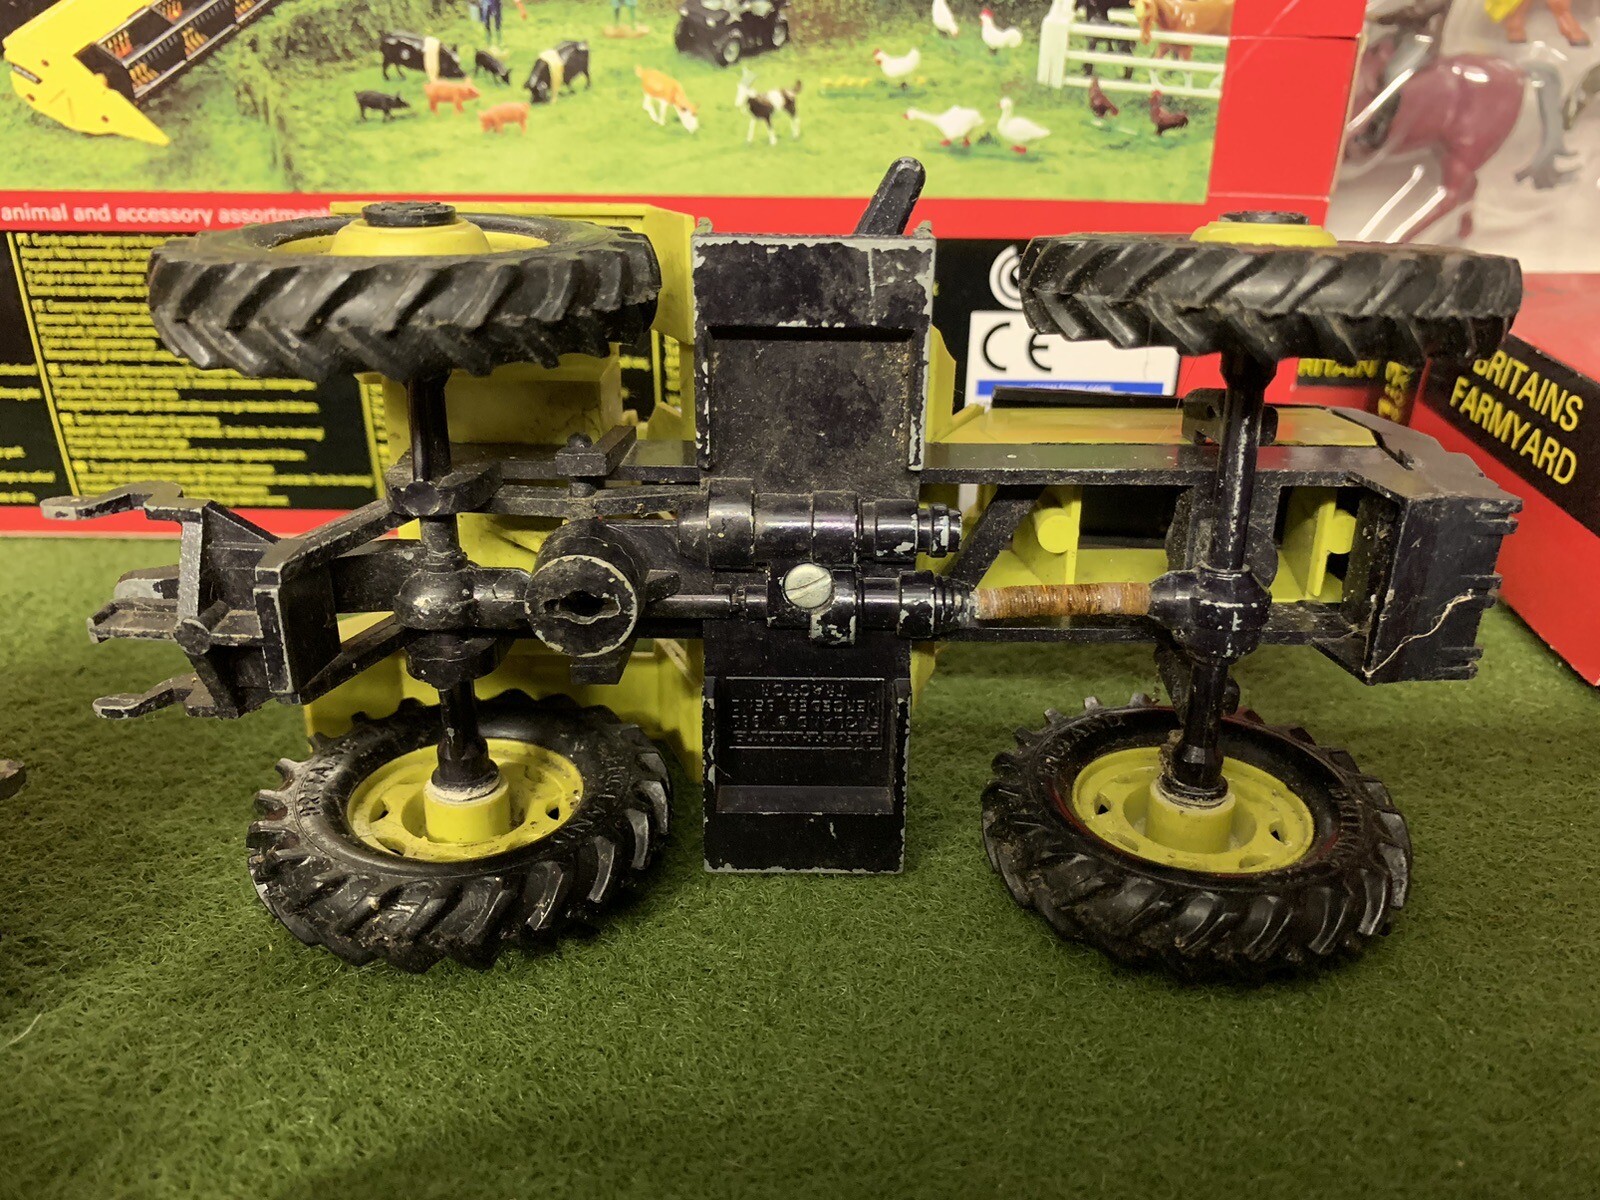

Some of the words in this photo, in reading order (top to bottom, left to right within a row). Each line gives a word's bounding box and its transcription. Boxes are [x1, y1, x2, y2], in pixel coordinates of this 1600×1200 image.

[1, 203, 66, 222] animal
[73, 203, 110, 222] and
[115, 206, 213, 226] accessory
[1450, 376, 1577, 485] FARMYARD
